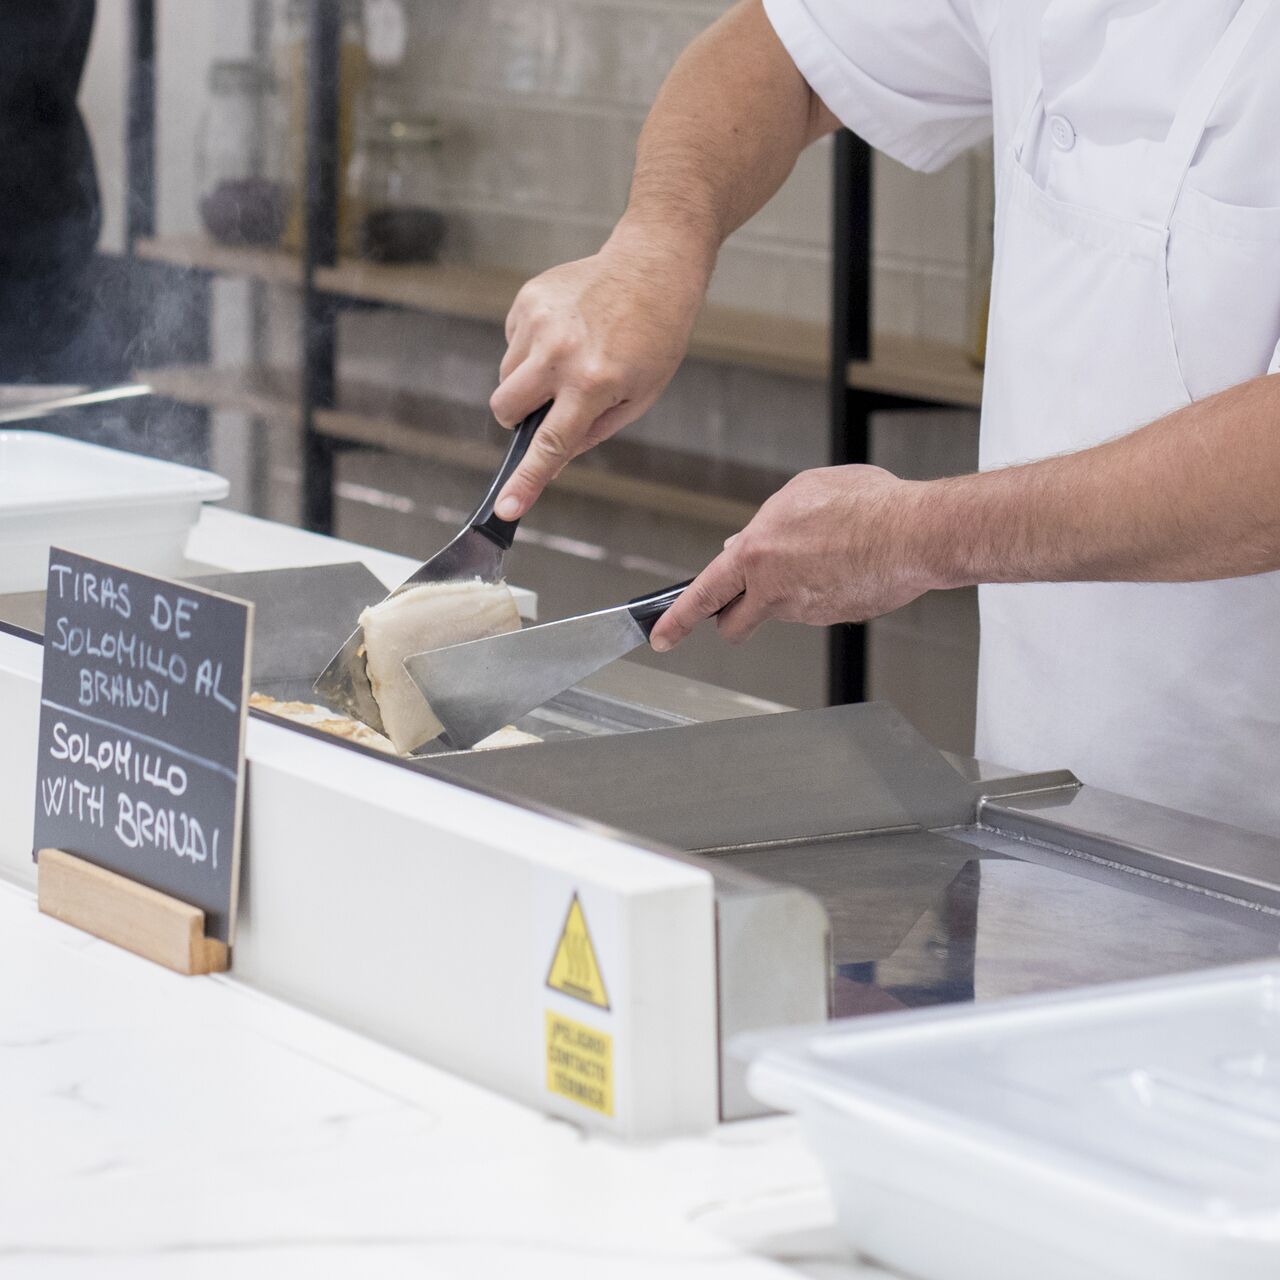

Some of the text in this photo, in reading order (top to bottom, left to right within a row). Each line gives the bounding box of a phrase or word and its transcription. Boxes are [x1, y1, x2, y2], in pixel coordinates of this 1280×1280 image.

[50, 564, 199, 640] TIRAS DE
[51, 616, 238, 713] SOLOMILLO AL
[77, 667, 169, 717] BRANDI
[49, 721, 188, 797] SOLOMILLO
[41, 775, 220, 870] WITH BRANDI
